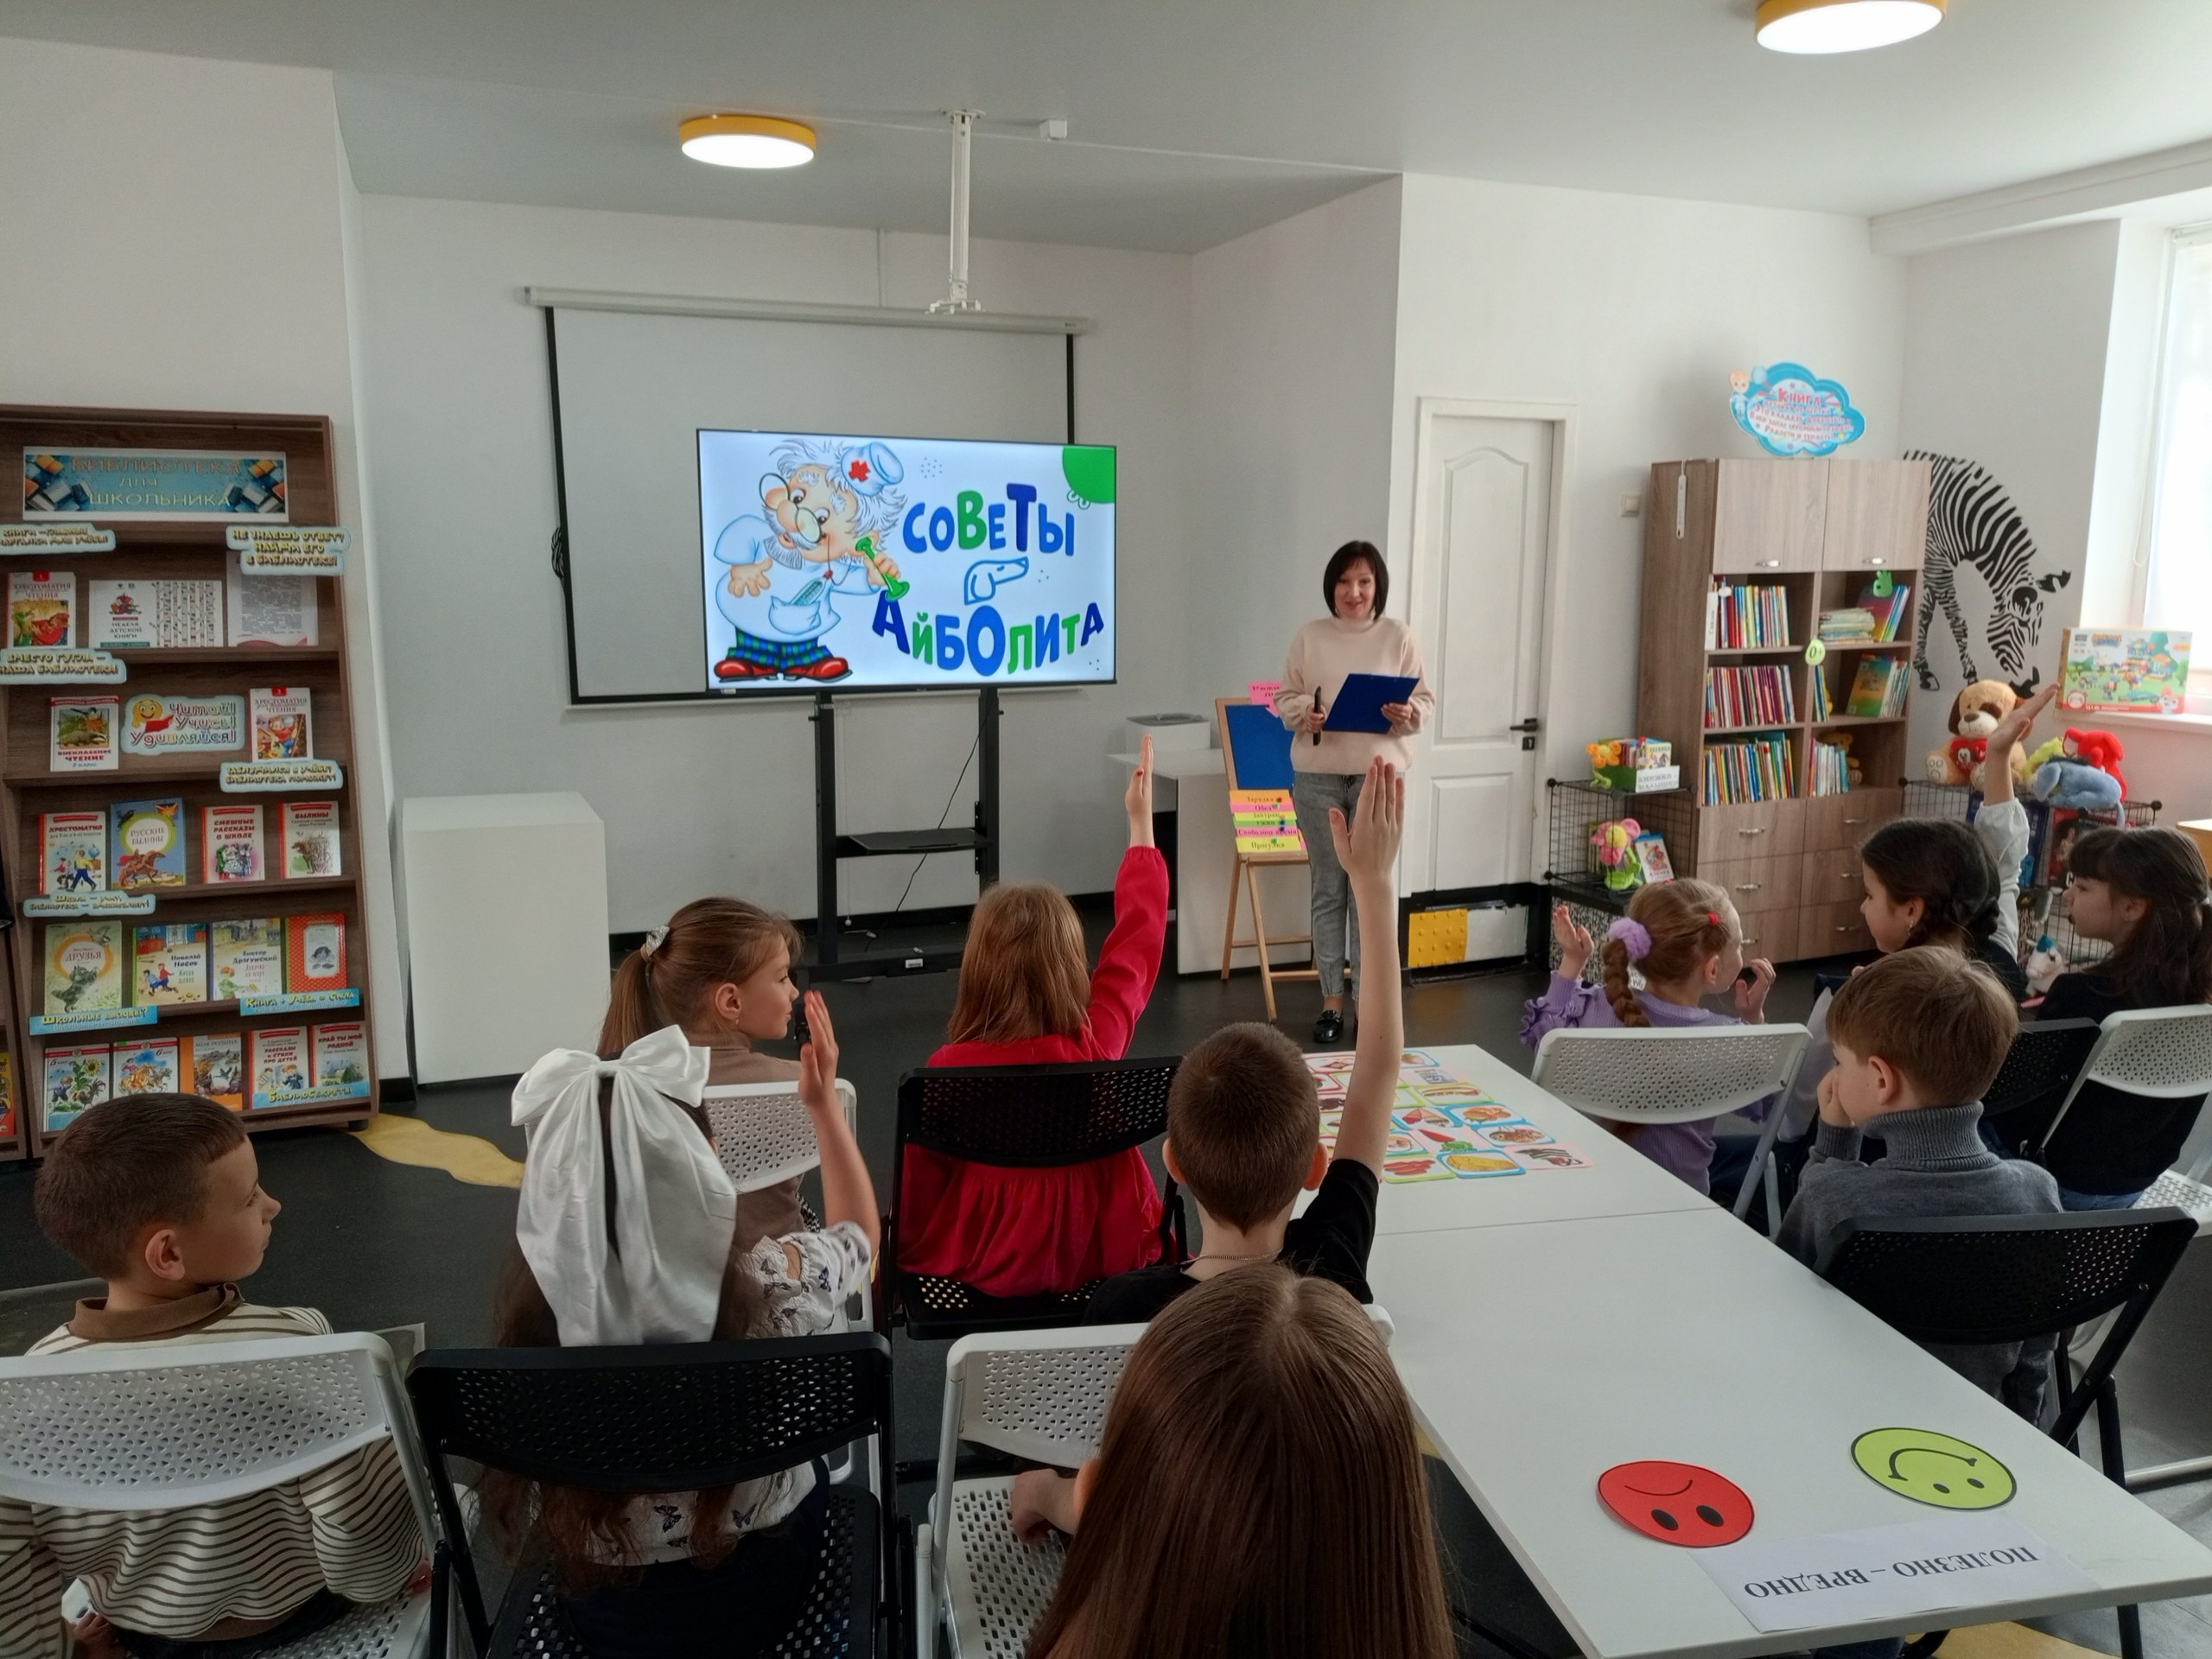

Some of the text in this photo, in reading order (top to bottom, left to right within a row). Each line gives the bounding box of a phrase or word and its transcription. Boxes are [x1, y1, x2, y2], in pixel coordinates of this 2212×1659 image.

[1778, 387, 1821, 405] КНИГА
[72, 456, 241, 474] БИБЛИОТЕКА
[89, 493, 232, 507] ШКОЛЬНИКА
[903, 483, 1075, 556] СОВЕТЫ
[232, 530, 249, 540] НЕ
[251, 530, 300, 541] ЗНАЕШЬ
[254, 542, 325, 554] НАЙДИ ЕГО
[257, 556, 337, 567] БИБЛИОТЕКЕ!
[872, 589, 1104, 677] АЙБОЛИТА
[7, 653, 54, 664] ВМЕСТО
[169, 702, 236, 717] Читай!
[175, 716, 236, 729] Учись!
[130, 731, 236, 748] Удивляйся!
[48, 824, 103, 833] ХРЕСТОМАТИЯ
[130, 828, 165, 837] РУССКИЕ
[131, 836, 164, 846] БЫЛИНЫ
[65, 951, 102, 962] ДРУЗЬЯ
[318, 1035, 335, 1044] КРАЙ
[1892, 1547, 2041, 1578] ПОЛЕЗНО
[1744, 1567, 1872, 1599] ВРЕДНО
